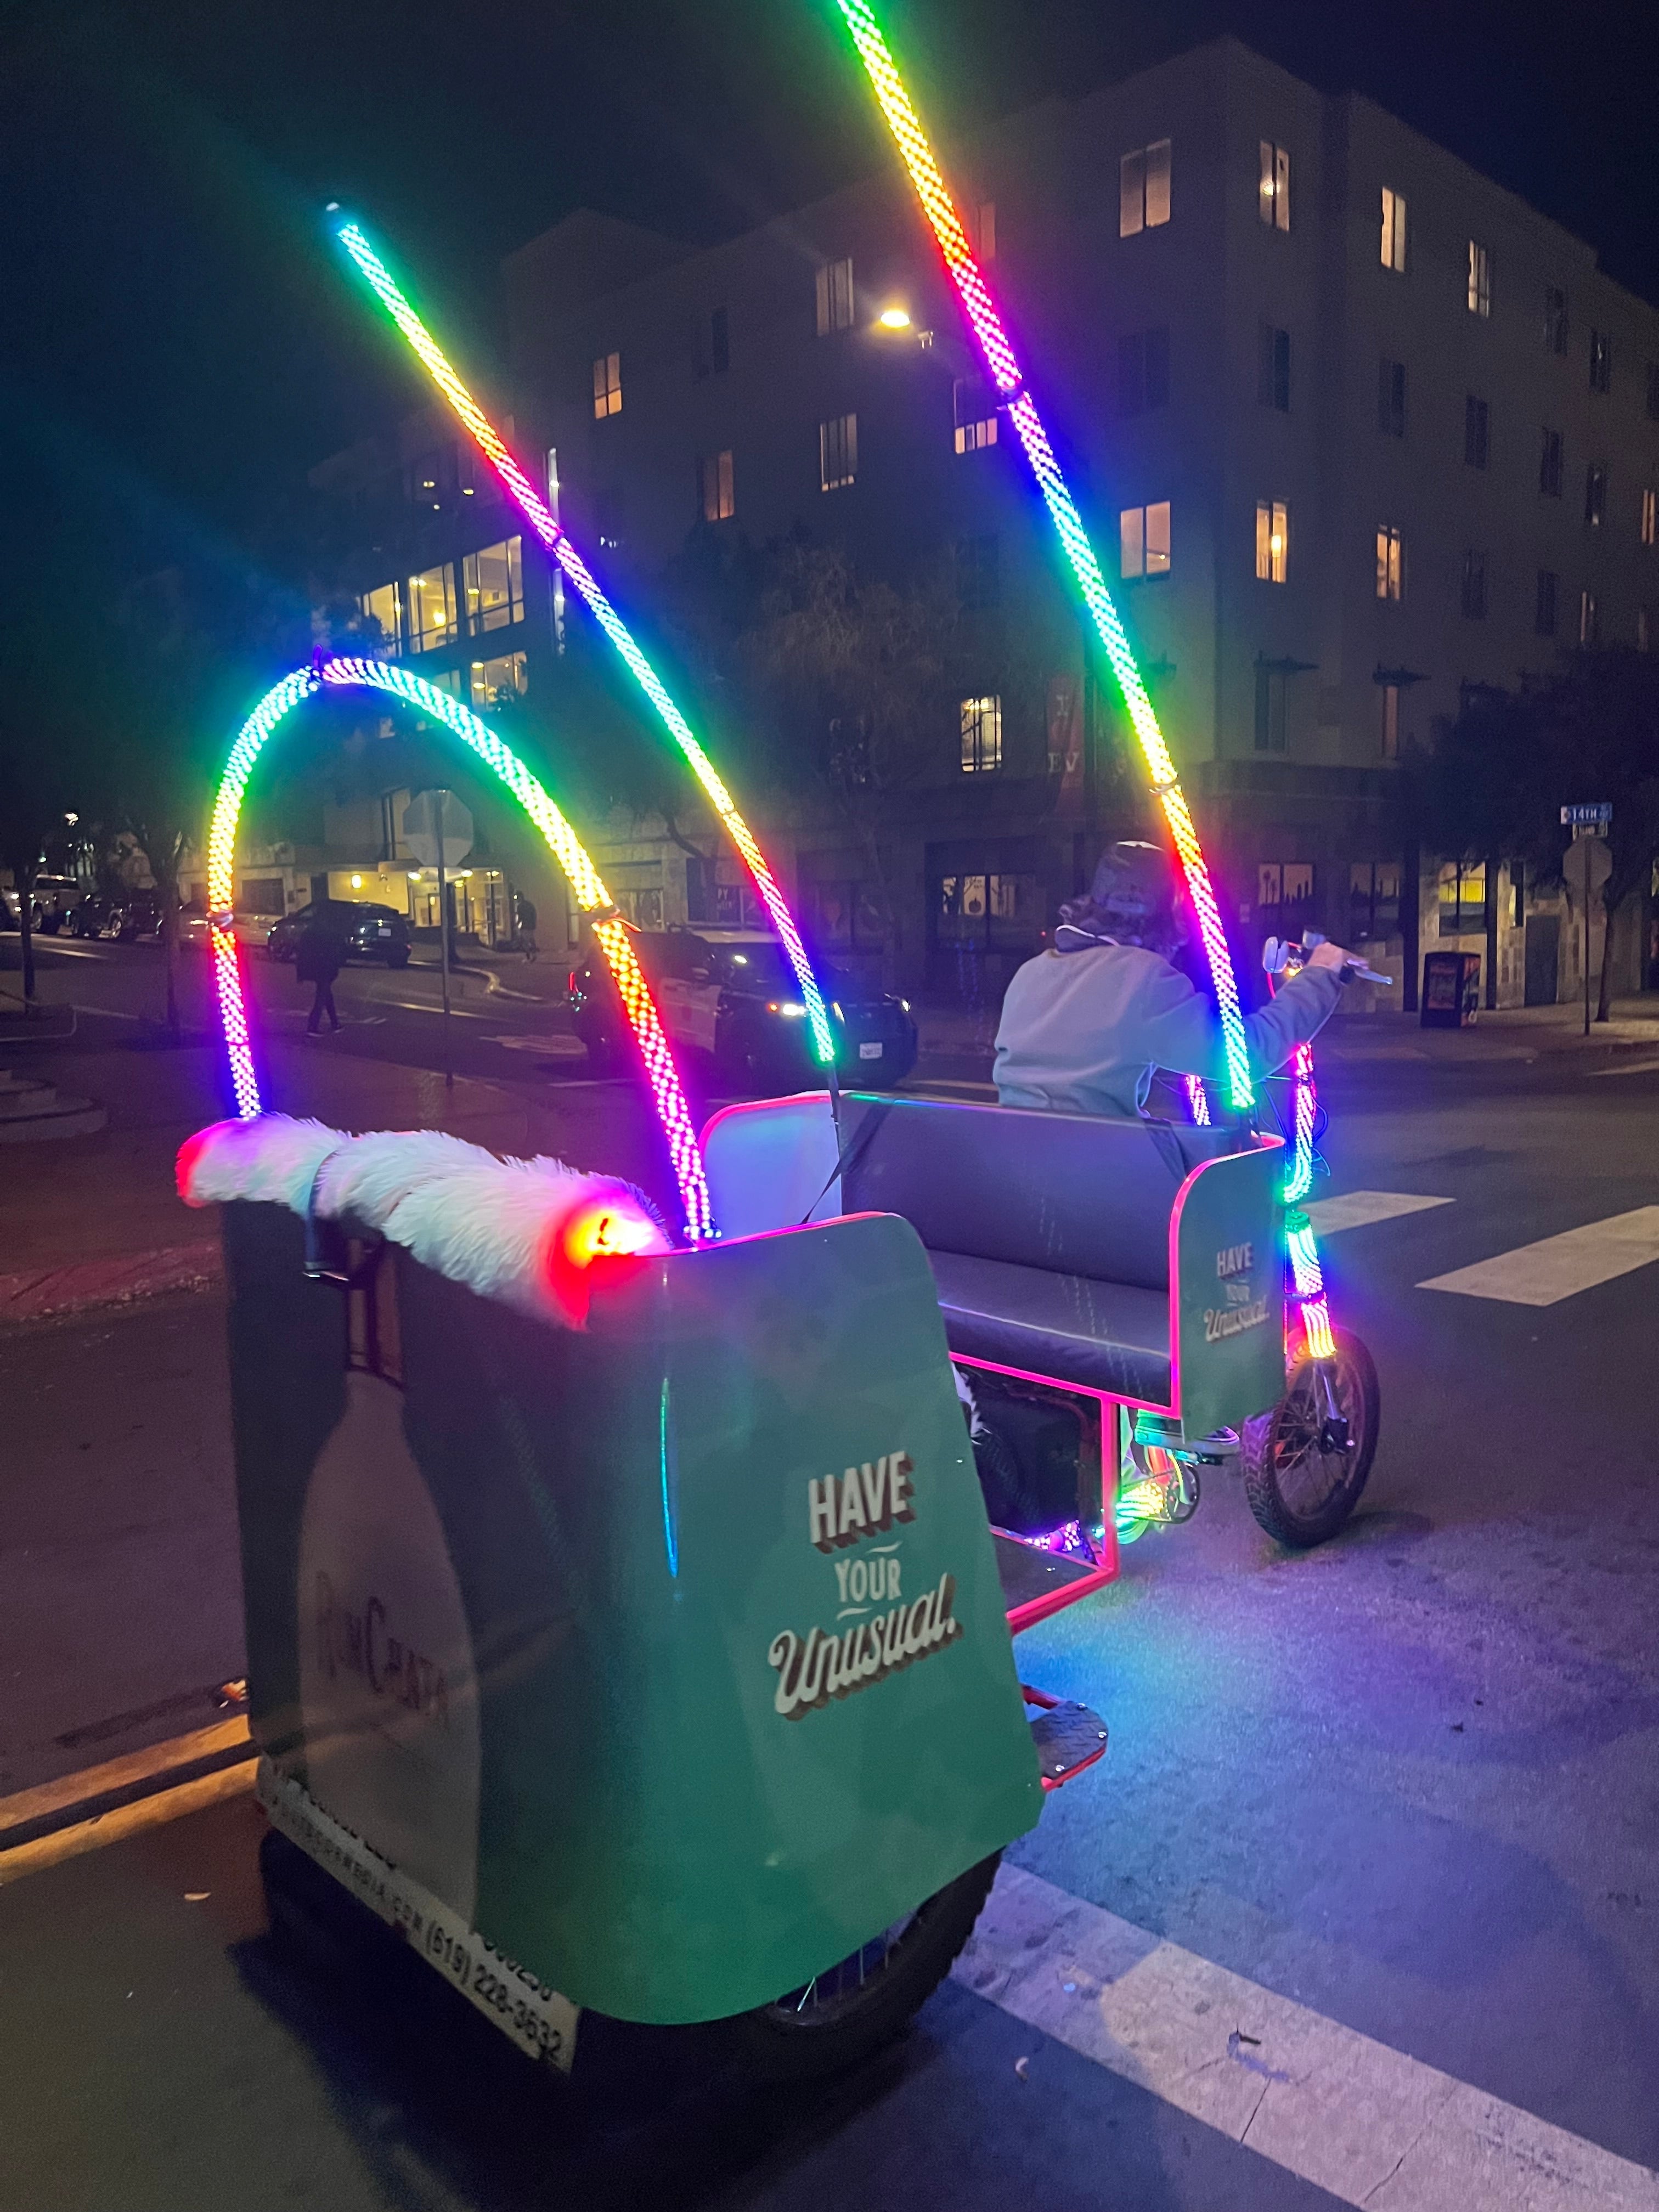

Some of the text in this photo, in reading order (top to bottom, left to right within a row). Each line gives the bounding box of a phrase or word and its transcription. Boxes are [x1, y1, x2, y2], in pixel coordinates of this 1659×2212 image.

[1573, 807, 1597, 821] 14TH
[1217, 1242, 1253, 1280] HAVE
[808, 1450, 912, 1549] HAVE
[834, 1557, 901, 1602] YOUR
[769, 1572, 959, 1717] Unusual.
[426, 1920, 471, 1986] (619)
